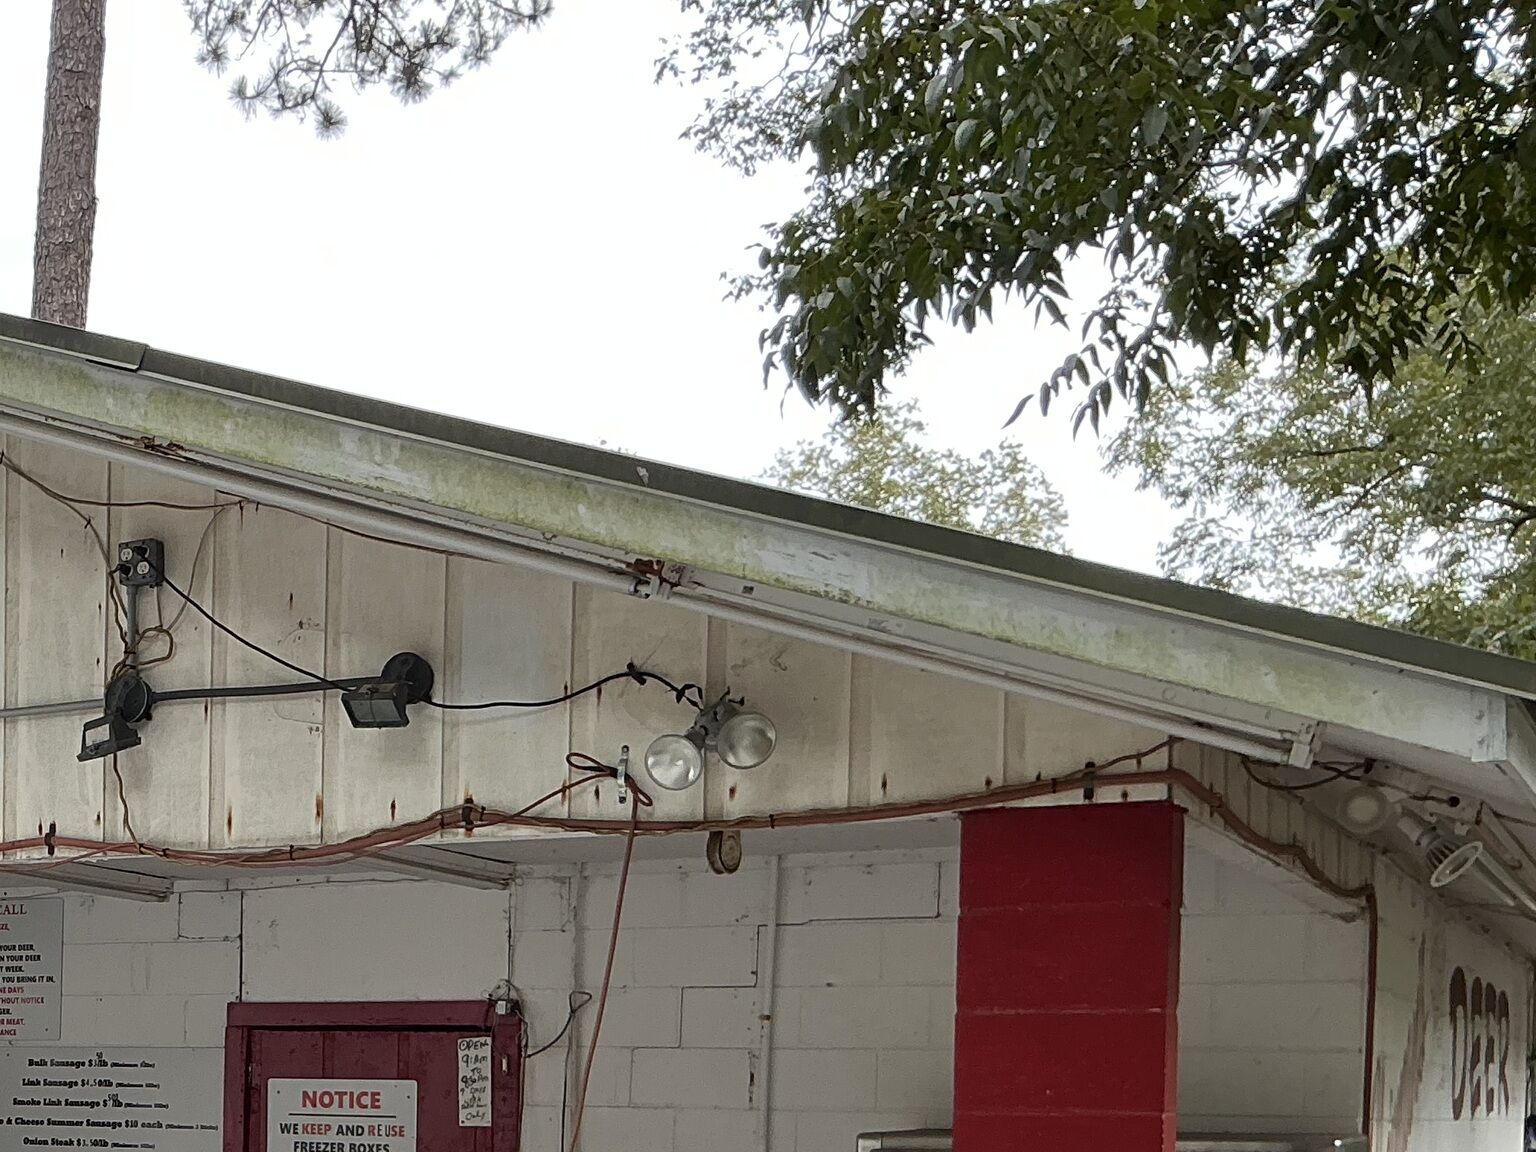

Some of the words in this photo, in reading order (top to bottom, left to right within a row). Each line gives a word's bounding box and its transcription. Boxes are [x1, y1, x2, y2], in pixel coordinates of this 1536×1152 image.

[0, 944, 17, 952] YOUR
[2, 976, 15, 984] YOU
[1449, 965, 1510, 1121] DEER
[28, 1059, 47, 1067] Bulk
[49, 1059, 86, 1069] Sausage
[22, 1079, 41, 1087] Link
[42, 1079, 79, 1089] Sausage
[13, 1098, 41, 1106] Smoke
[42, 1098, 62, 1106] Link
[63, 1099, 100, 1109] Sausage
[302, 1090, 381, 1109] NOTICE
[14, 1117, 45, 1126] Cheese
[46, 1118, 84, 1127] Summer
[85, 1119, 122, 1130] Sausage
[124, 1119, 138, 1129] $10
[140, 1121, 163, 1129] each
[279, 1123, 299, 1135] WE
[301, 1124, 332, 1135] KEEP
[336, 1125, 365, 1137] AND
[23, 1137, 49, 1146] Onion
[50, 1137, 75, 1146] Steak
